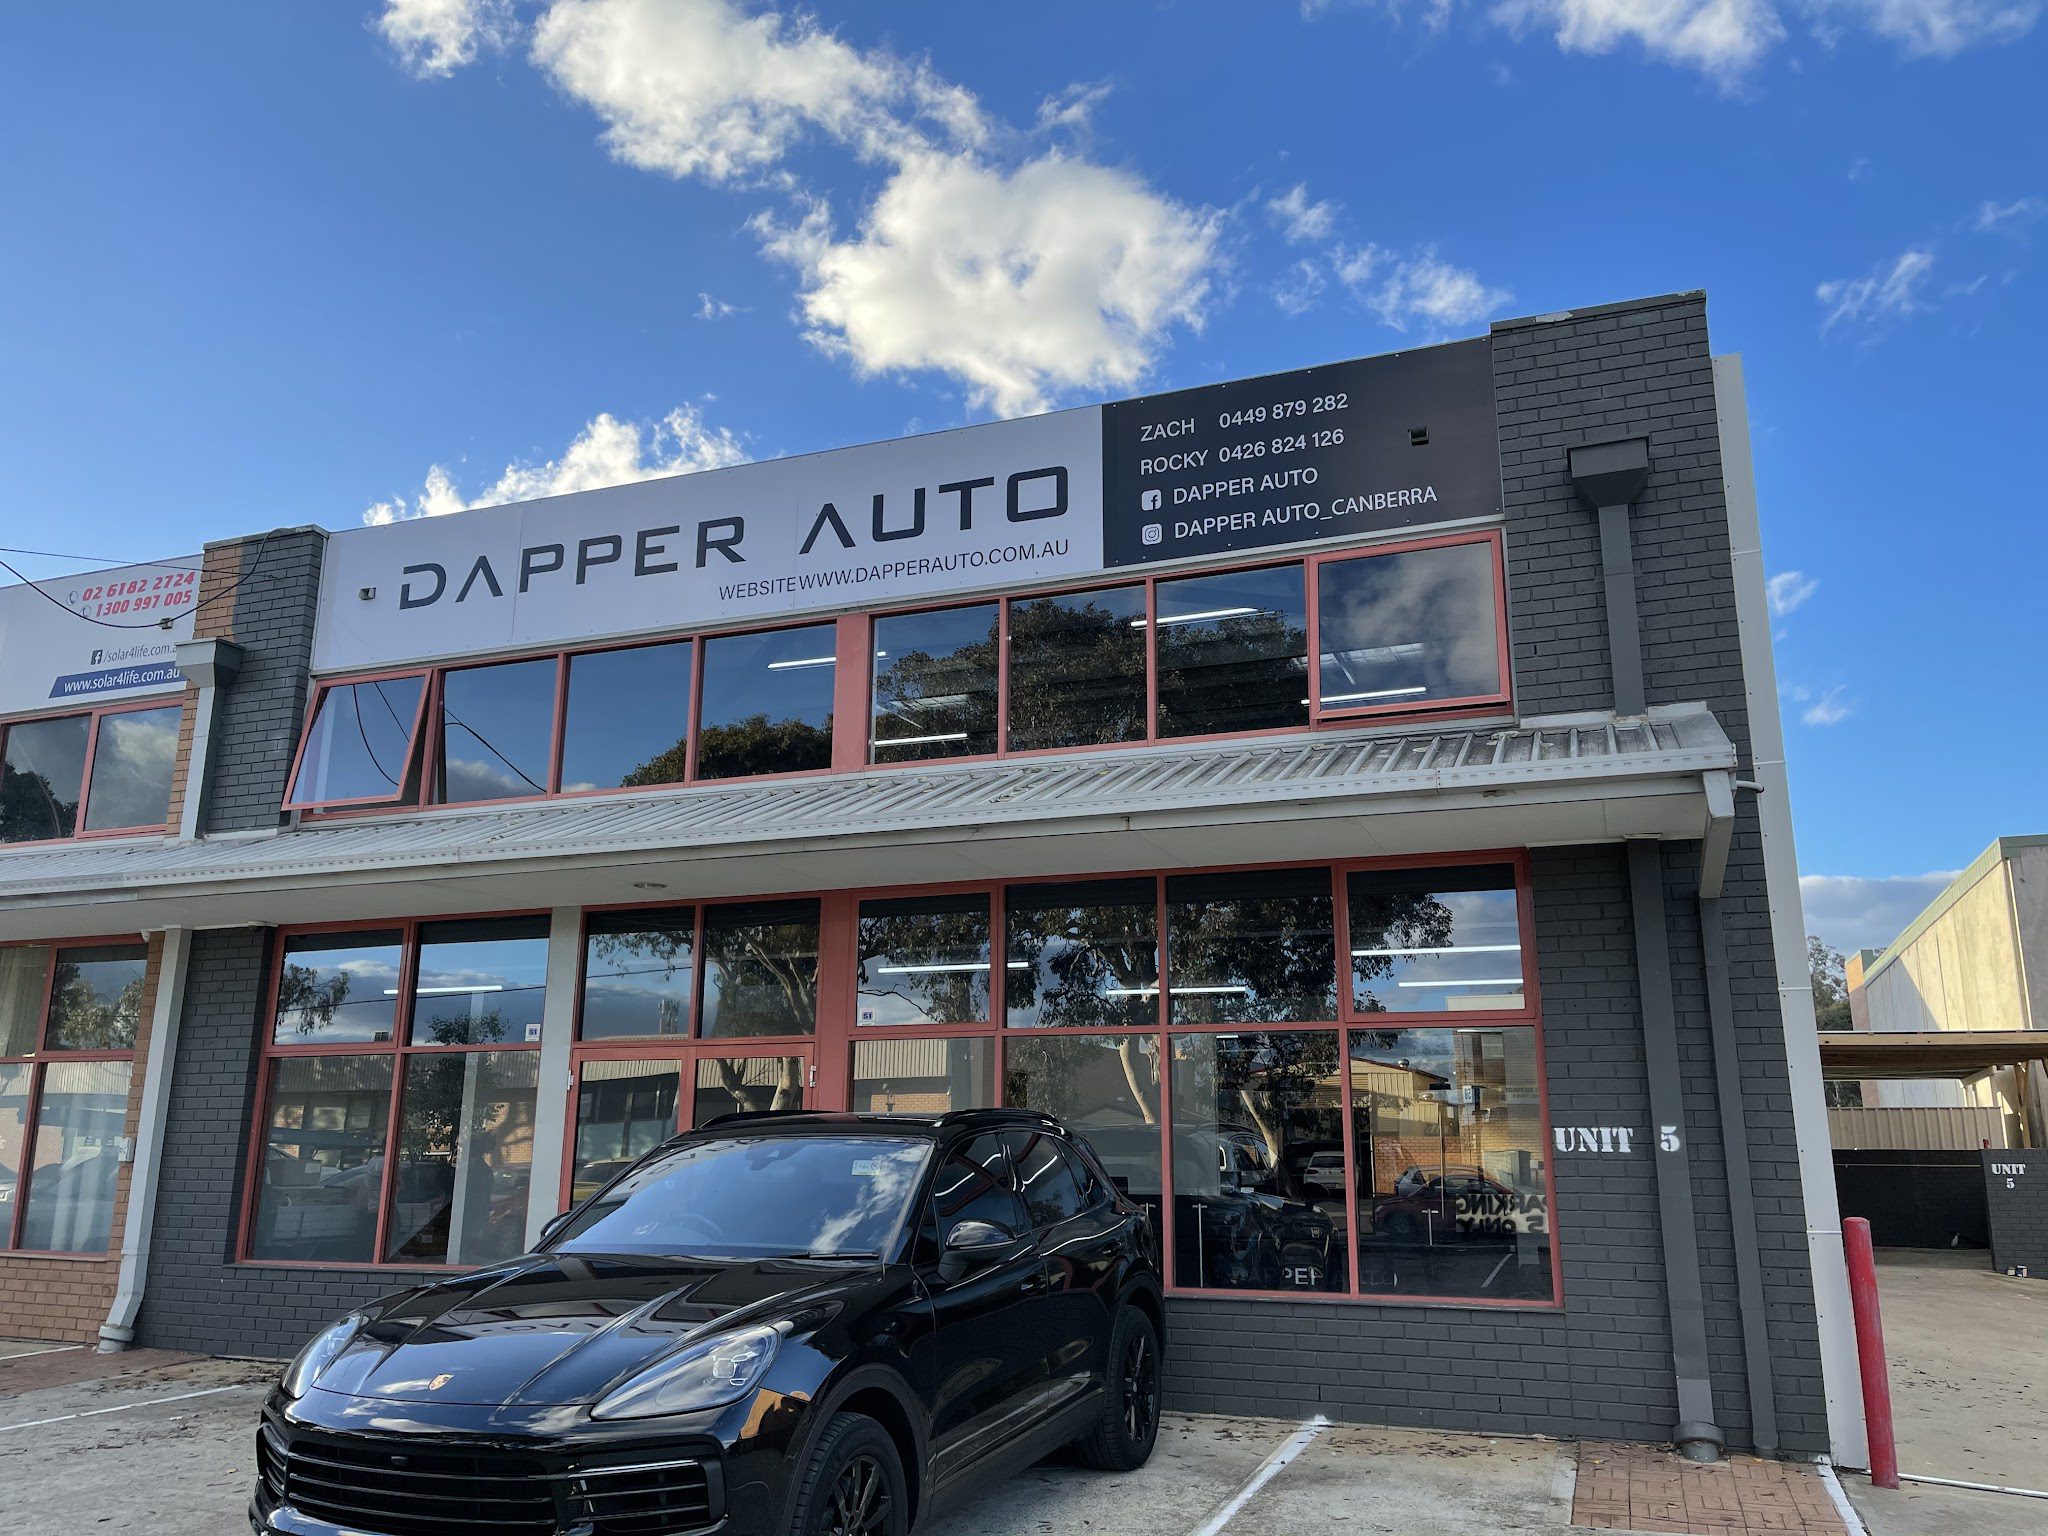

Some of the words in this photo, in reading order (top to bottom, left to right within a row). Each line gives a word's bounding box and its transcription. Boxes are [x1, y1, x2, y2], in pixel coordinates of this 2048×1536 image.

[1140, 418, 1195, 442] ZACH
[1219, 407, 1267, 429] 0449
[1272, 399, 1307, 421] 879
[1312, 393, 1349, 414] 282
[1140, 450, 1208, 475] ROCKY
[1219, 442, 1266, 463] 0426
[1271, 434, 1307, 455] 824
[1311, 428, 1344, 449] 126
[1173, 477, 1254, 505] DAPPER
[1260, 467, 1318, 491] AUTO
[1174, 512, 1256, 539] DAPPER
[1262, 485, 1438, 526] AUTO_CANBERRA
[399, 516, 747, 611] DAPPER
[798, 466, 1069, 555] AUTO
[798, 539, 1069, 591] WWW.DAPPERAUTO.COM.AU
[82, 586, 103, 602] 02
[106, 579, 148, 598] 6182
[152, 571, 196, 591] 2724
[95, 600, 130, 617] 1300
[132, 594, 161, 612] 997
[163, 589, 193, 606] 005
[64, 668, 181, 693] www.solar4life.com.au
[1553, 1126, 1634, 1153] UNIT
[1660, 1125, 1681, 1152] 5
[1990, 1163, 2026, 1175] UNIT
[2006, 1178, 2015, 1189] 5
